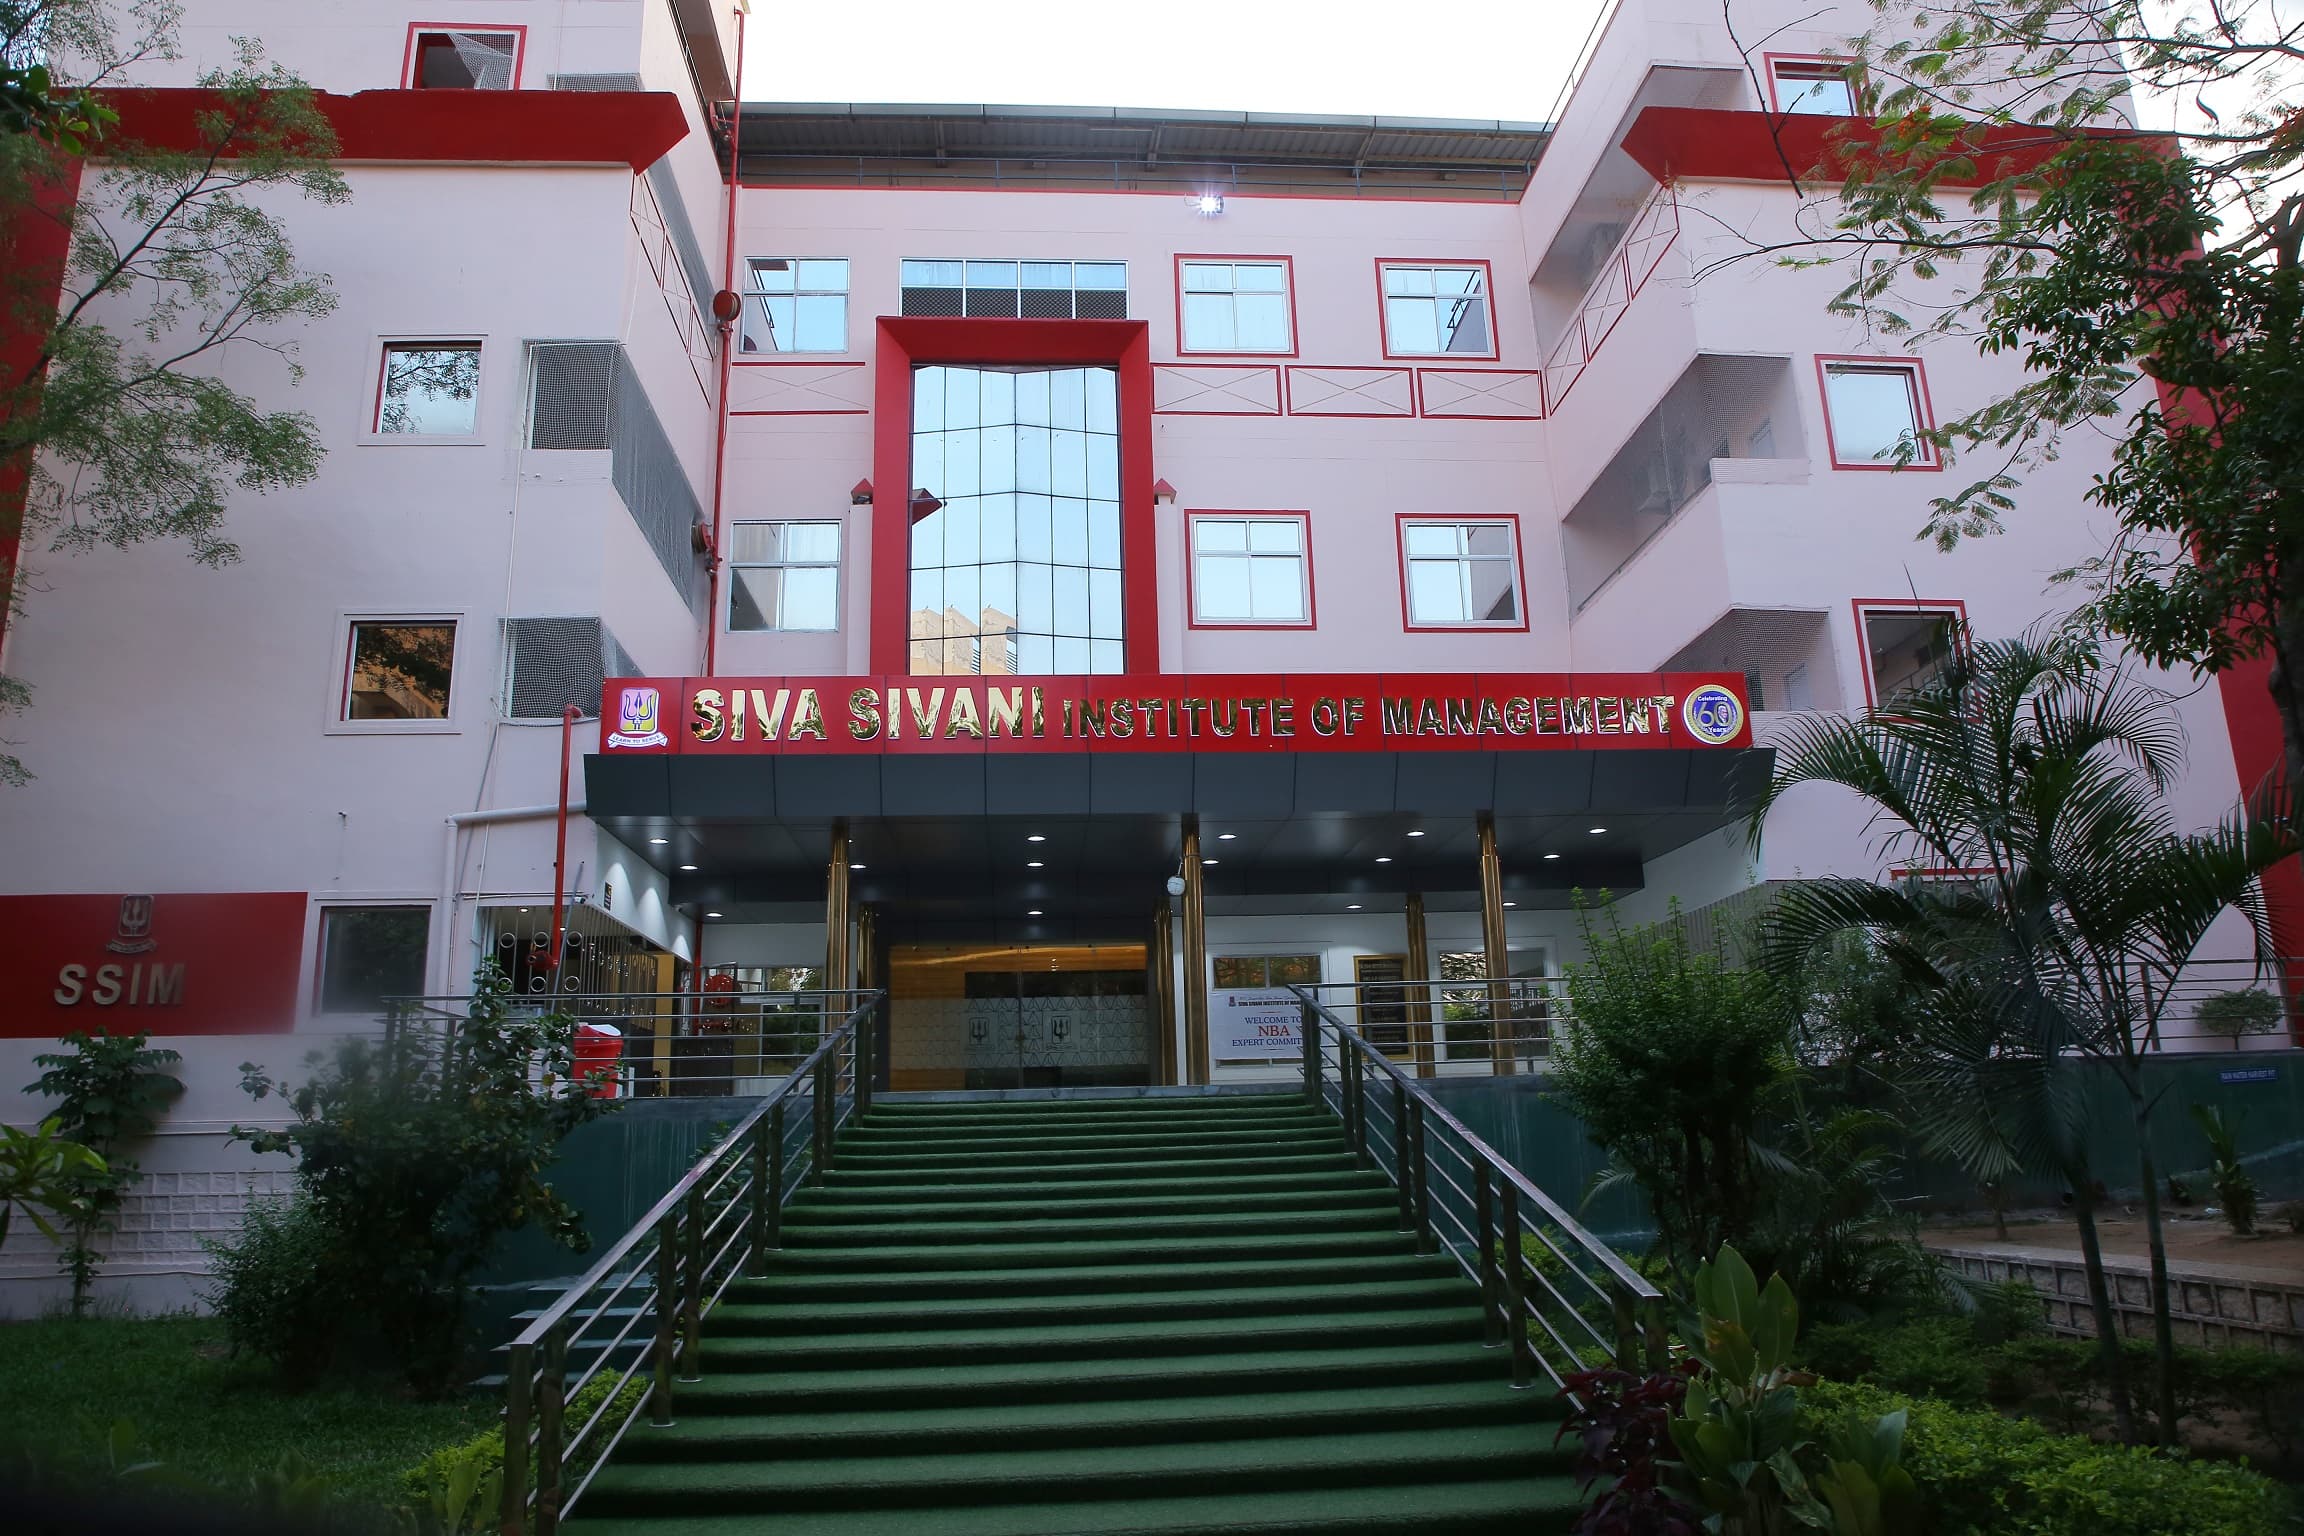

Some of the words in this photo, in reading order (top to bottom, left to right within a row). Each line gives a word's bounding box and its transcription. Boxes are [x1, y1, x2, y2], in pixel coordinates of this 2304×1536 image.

[690, 688, 828, 742] SIVA
[847, 687, 1045, 741] SIVANI
[1063, 697, 1296, 738] INSTITUTE
[1311, 696, 1366, 737] OF
[1381, 695, 1675, 736] MANAGEMENT
[1698, 701, 1732, 727] 60
[53, 962, 187, 1006] SSIM
[1244, 1016, 1289, 1025] WELCOME
[1290, 1015, 1303, 1024] TO
[1258, 1025, 1291, 1037] NBA
[1232, 1038, 1265, 1047] EXPERT
[1266, 1037, 1304, 1046] COMMIT
